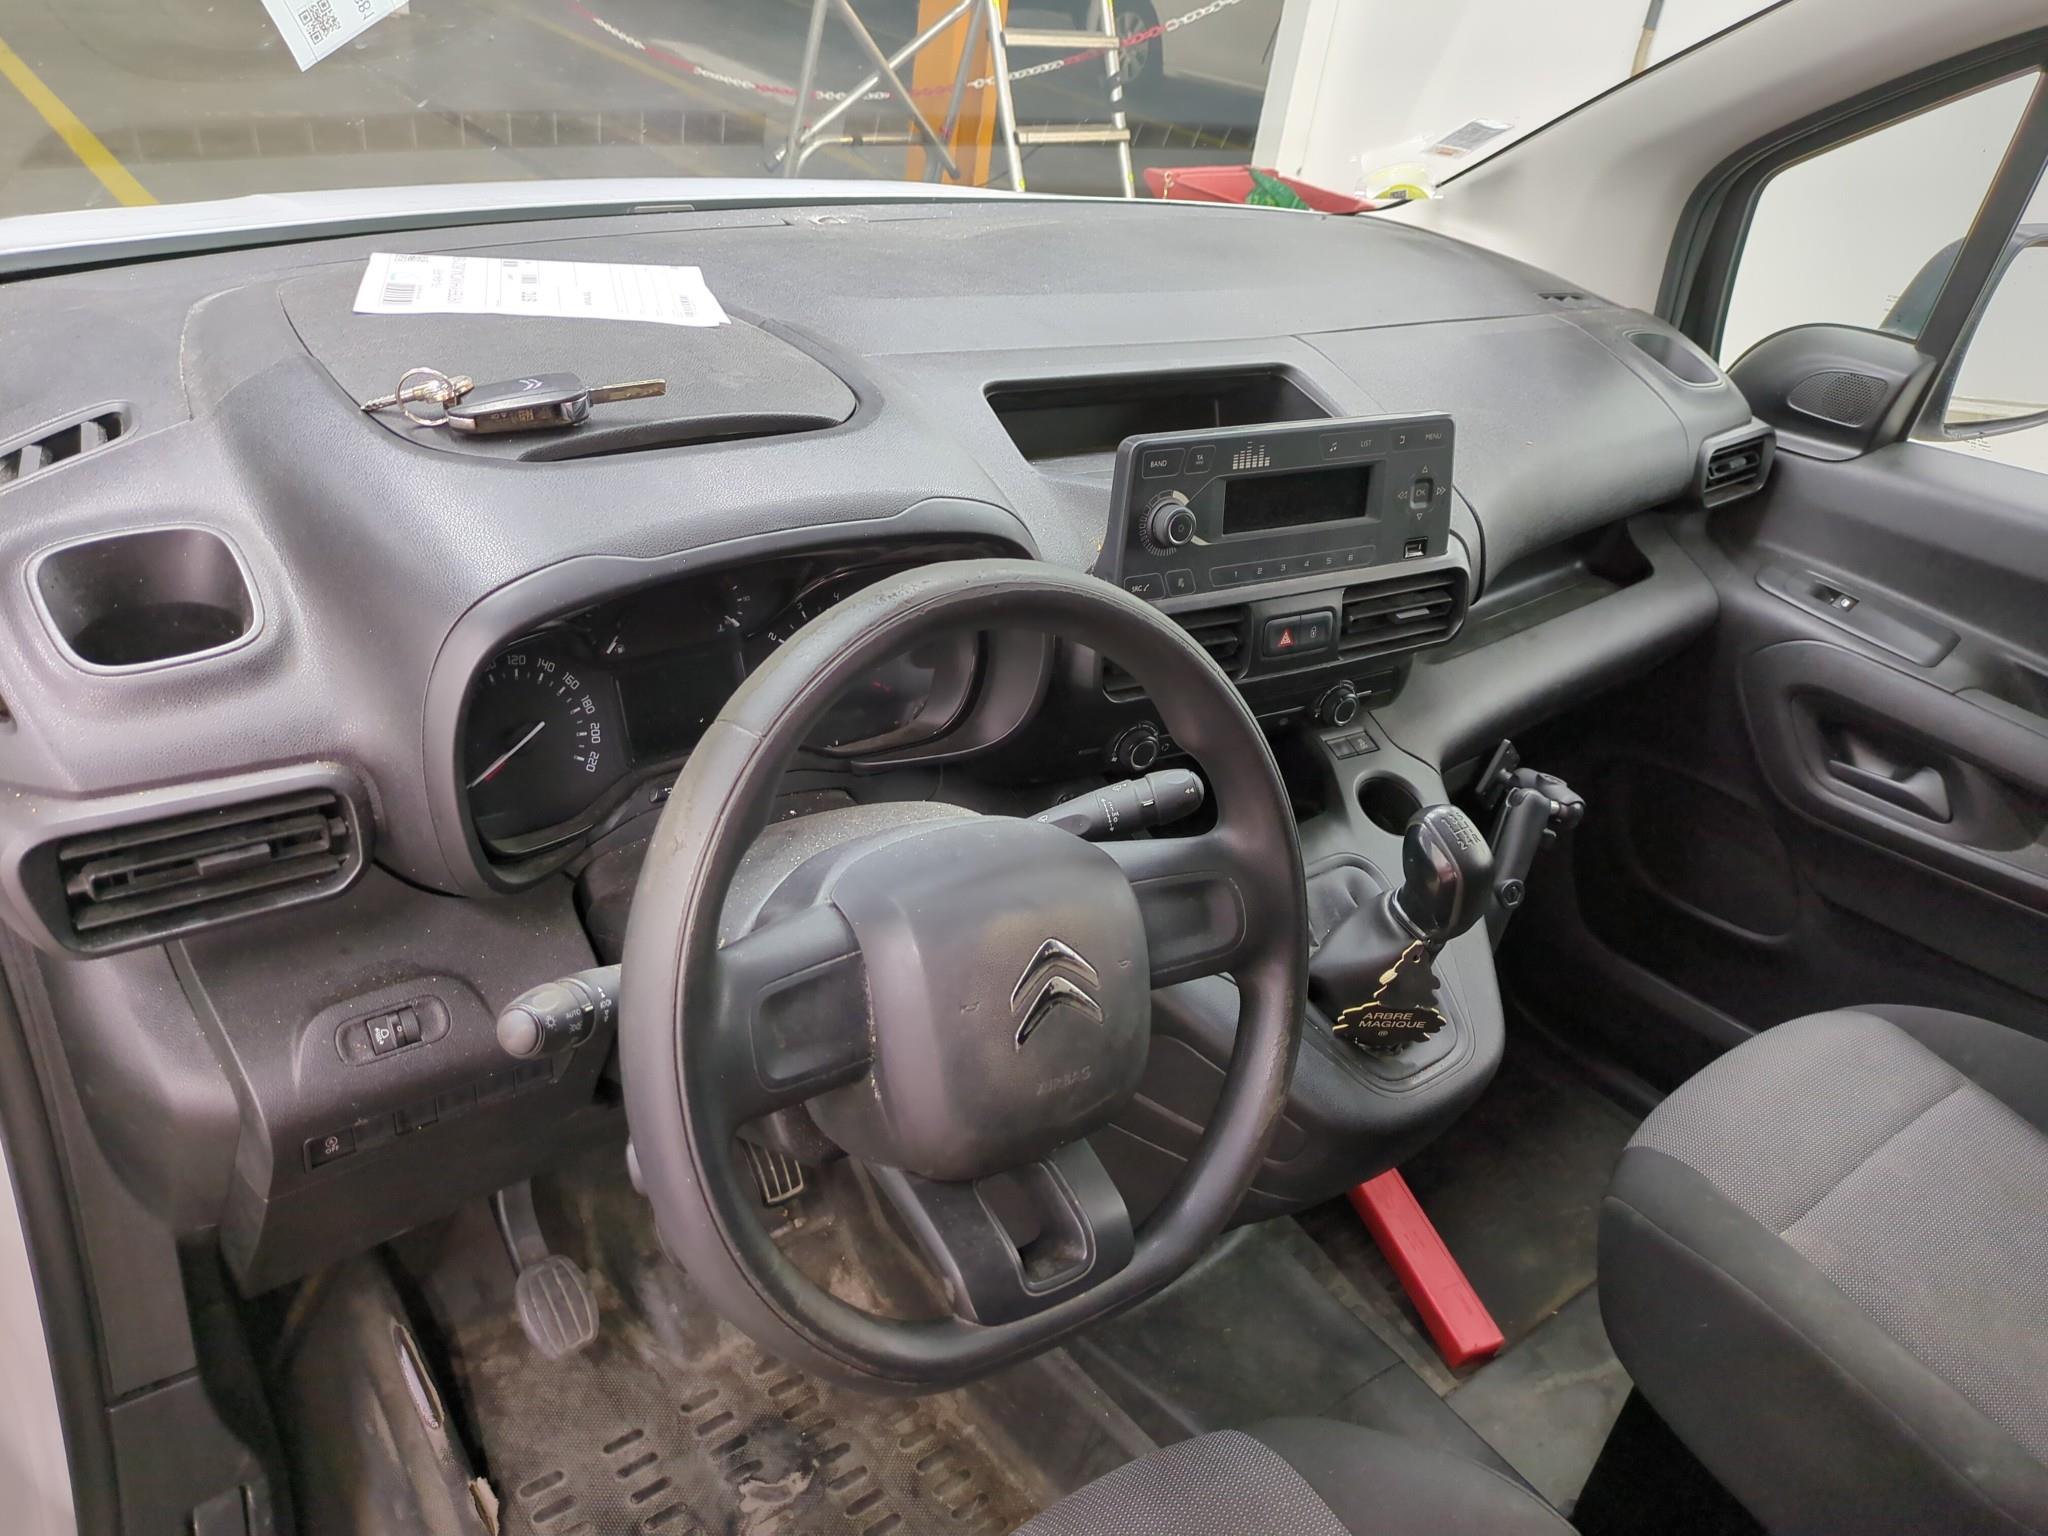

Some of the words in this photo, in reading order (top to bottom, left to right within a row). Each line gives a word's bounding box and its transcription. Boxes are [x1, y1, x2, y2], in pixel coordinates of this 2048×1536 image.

[1424, 433, 1442, 441] MENU
[1360, 439, 1372, 448] LIST
[1150, 459, 1168, 468] BAND
[507, 655, 526, 665] 120
[537, 657, 556, 673] 140
[562, 672, 580, 690] 160
[581, 694, 595, 715] 180
[590, 722, 601, 744] 200
[586, 751, 600, 773] 220
[566, 1008, 581, 1019] AUTO
[1362, 1012, 1414, 1021] ARBRE
[1358, 1020, 1427, 1029] MAGIQUE
[325, 1145, 340, 1155] OFF
